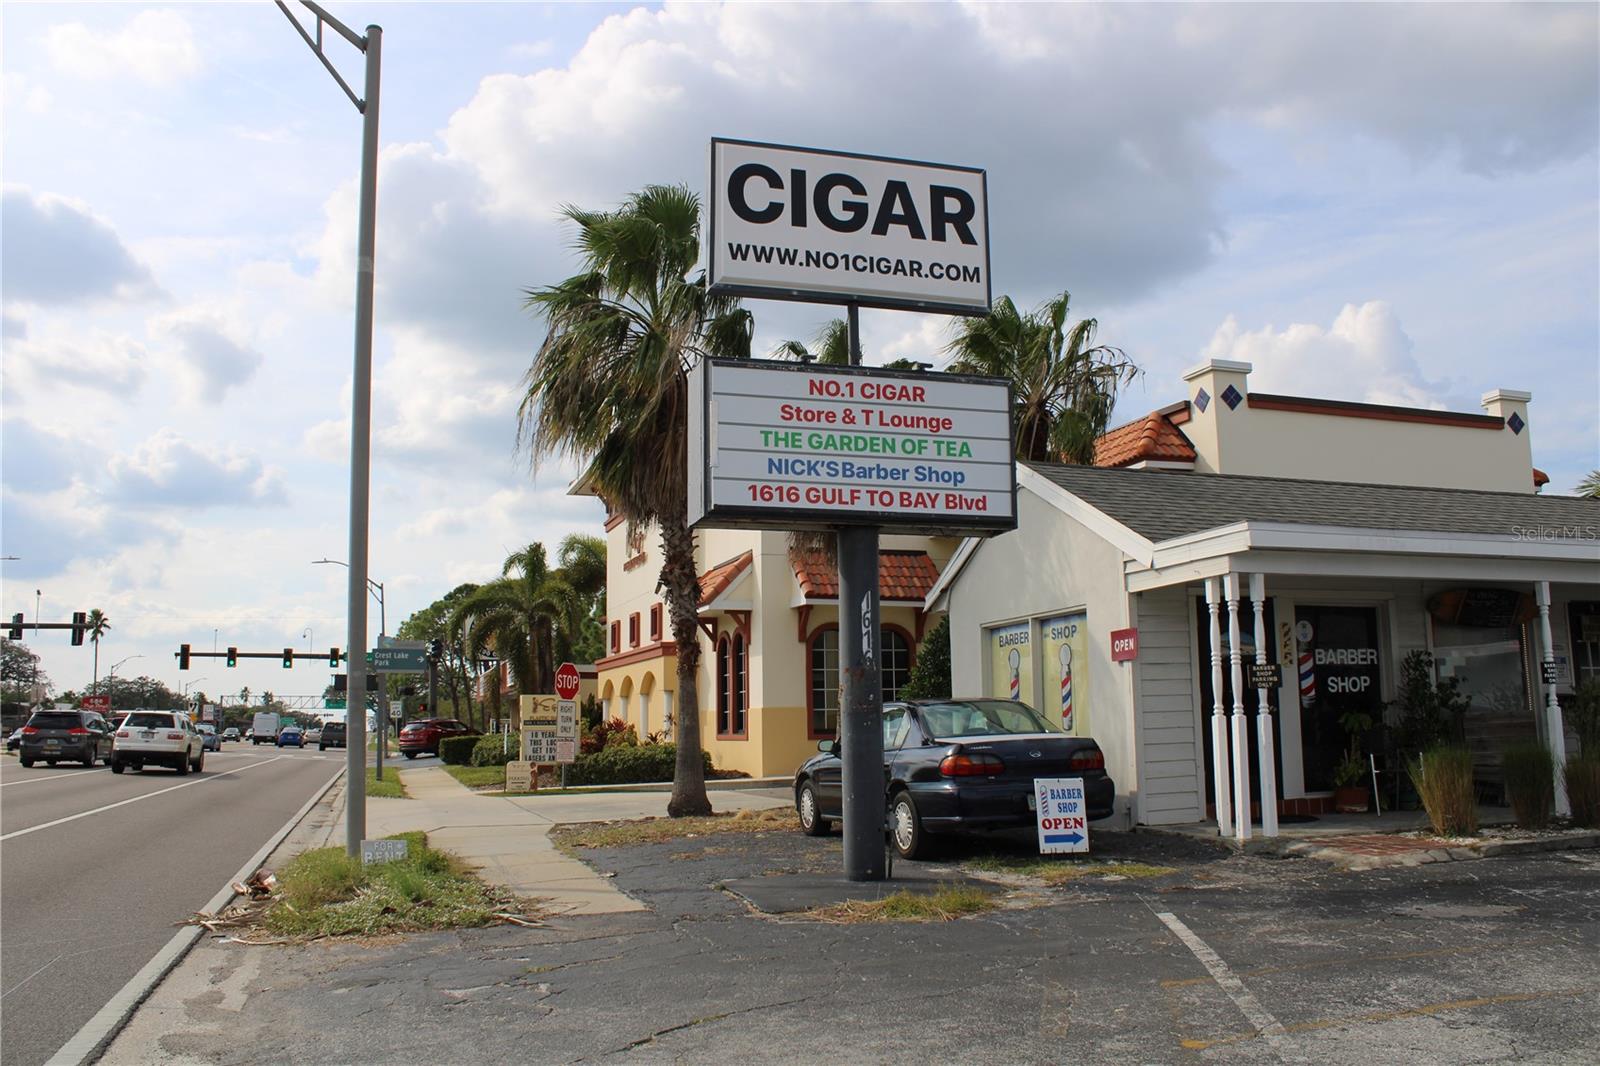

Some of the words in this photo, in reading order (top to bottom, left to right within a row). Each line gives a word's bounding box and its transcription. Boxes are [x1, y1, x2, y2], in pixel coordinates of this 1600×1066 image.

[727, 163, 978, 246] CIGAR
[728, 242, 981, 284] WWW.NO1CIGAR.COM
[809, 379, 855, 399] NO.1
[860, 382, 926, 402] CIGAR
[780, 404, 836, 424] Store
[842, 408, 857, 425] &
[861, 410, 874, 426] T
[879, 410, 953, 434] Lounge
[760, 430, 802, 449] THE
[808, 432, 897, 454] GARDEN
[901, 438, 929, 455] OF
[933, 440, 972, 458] TEA
[842, 460, 910, 481] Barber
[914, 465, 965, 488] Shop
[748, 484, 800, 504] 1616
[805, 487, 862, 506] GULF
[866, 489, 894, 507] TO
[899, 491, 941, 509] BAY
[945, 493, 987, 512] Blvd
[999, 631, 1029, 648] BARBER
[1051, 624, 1077, 640] SHOP
[1114, 637, 1134, 653] OPEN
[1314, 648, 1378, 665] BARBER
[556, 673, 580, 690] STOP
[1327, 675, 1370, 693] SHOP
[560, 705, 573, 713] RIGHT
[560, 715, 572, 723] TURN
[1050, 787, 1082, 800] BARBER
[1057, 802, 1078, 813] SHOP
[1041, 816, 1084, 831] OPEN
